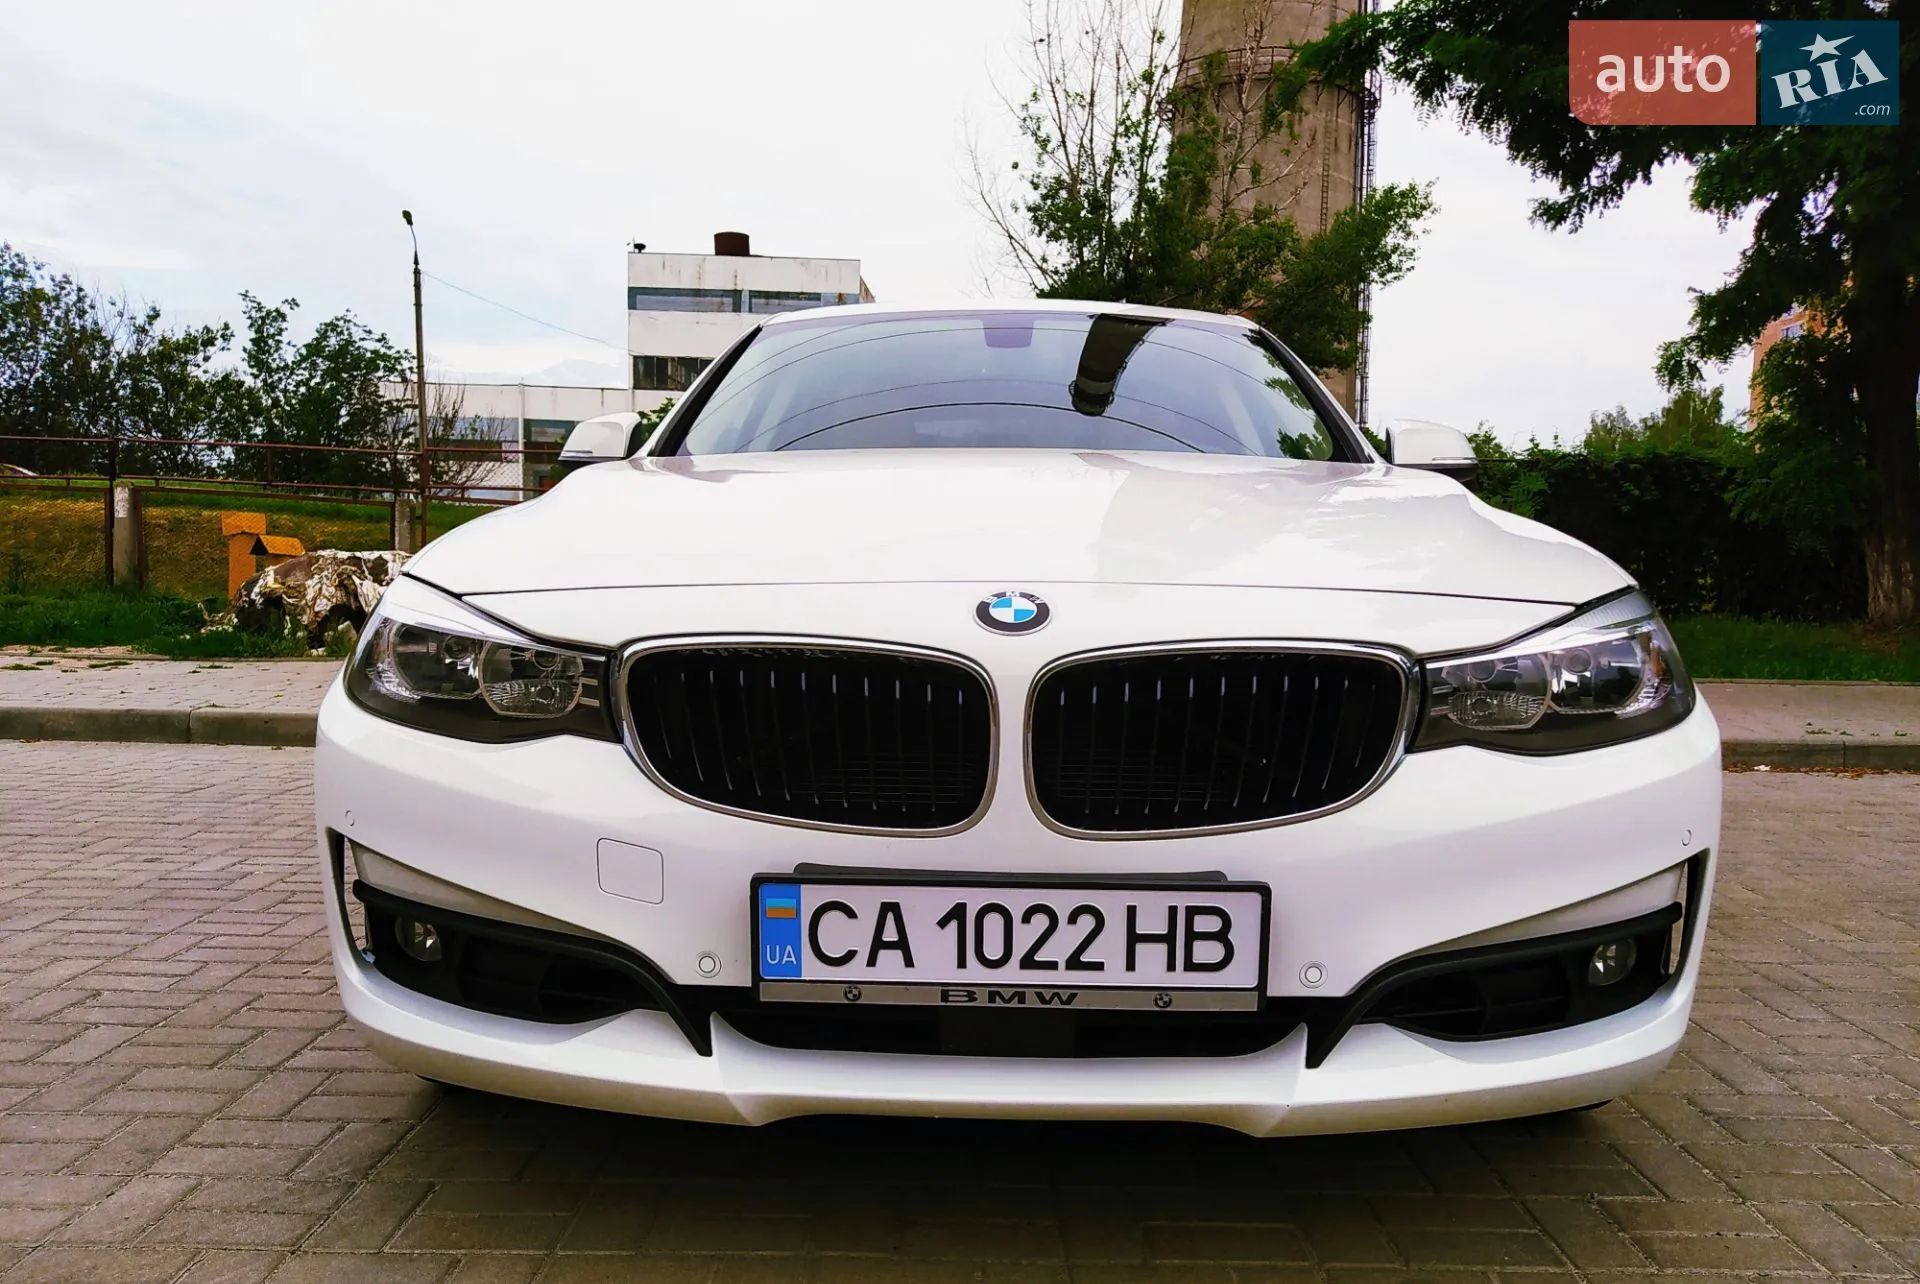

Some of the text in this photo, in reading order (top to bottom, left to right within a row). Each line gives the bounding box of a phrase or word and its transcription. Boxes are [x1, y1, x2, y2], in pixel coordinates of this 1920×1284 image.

[808, 900, 1235, 973] CA 1022 HB
[766, 945, 797, 965] UA
[940, 988, 1078, 1006] BMW
